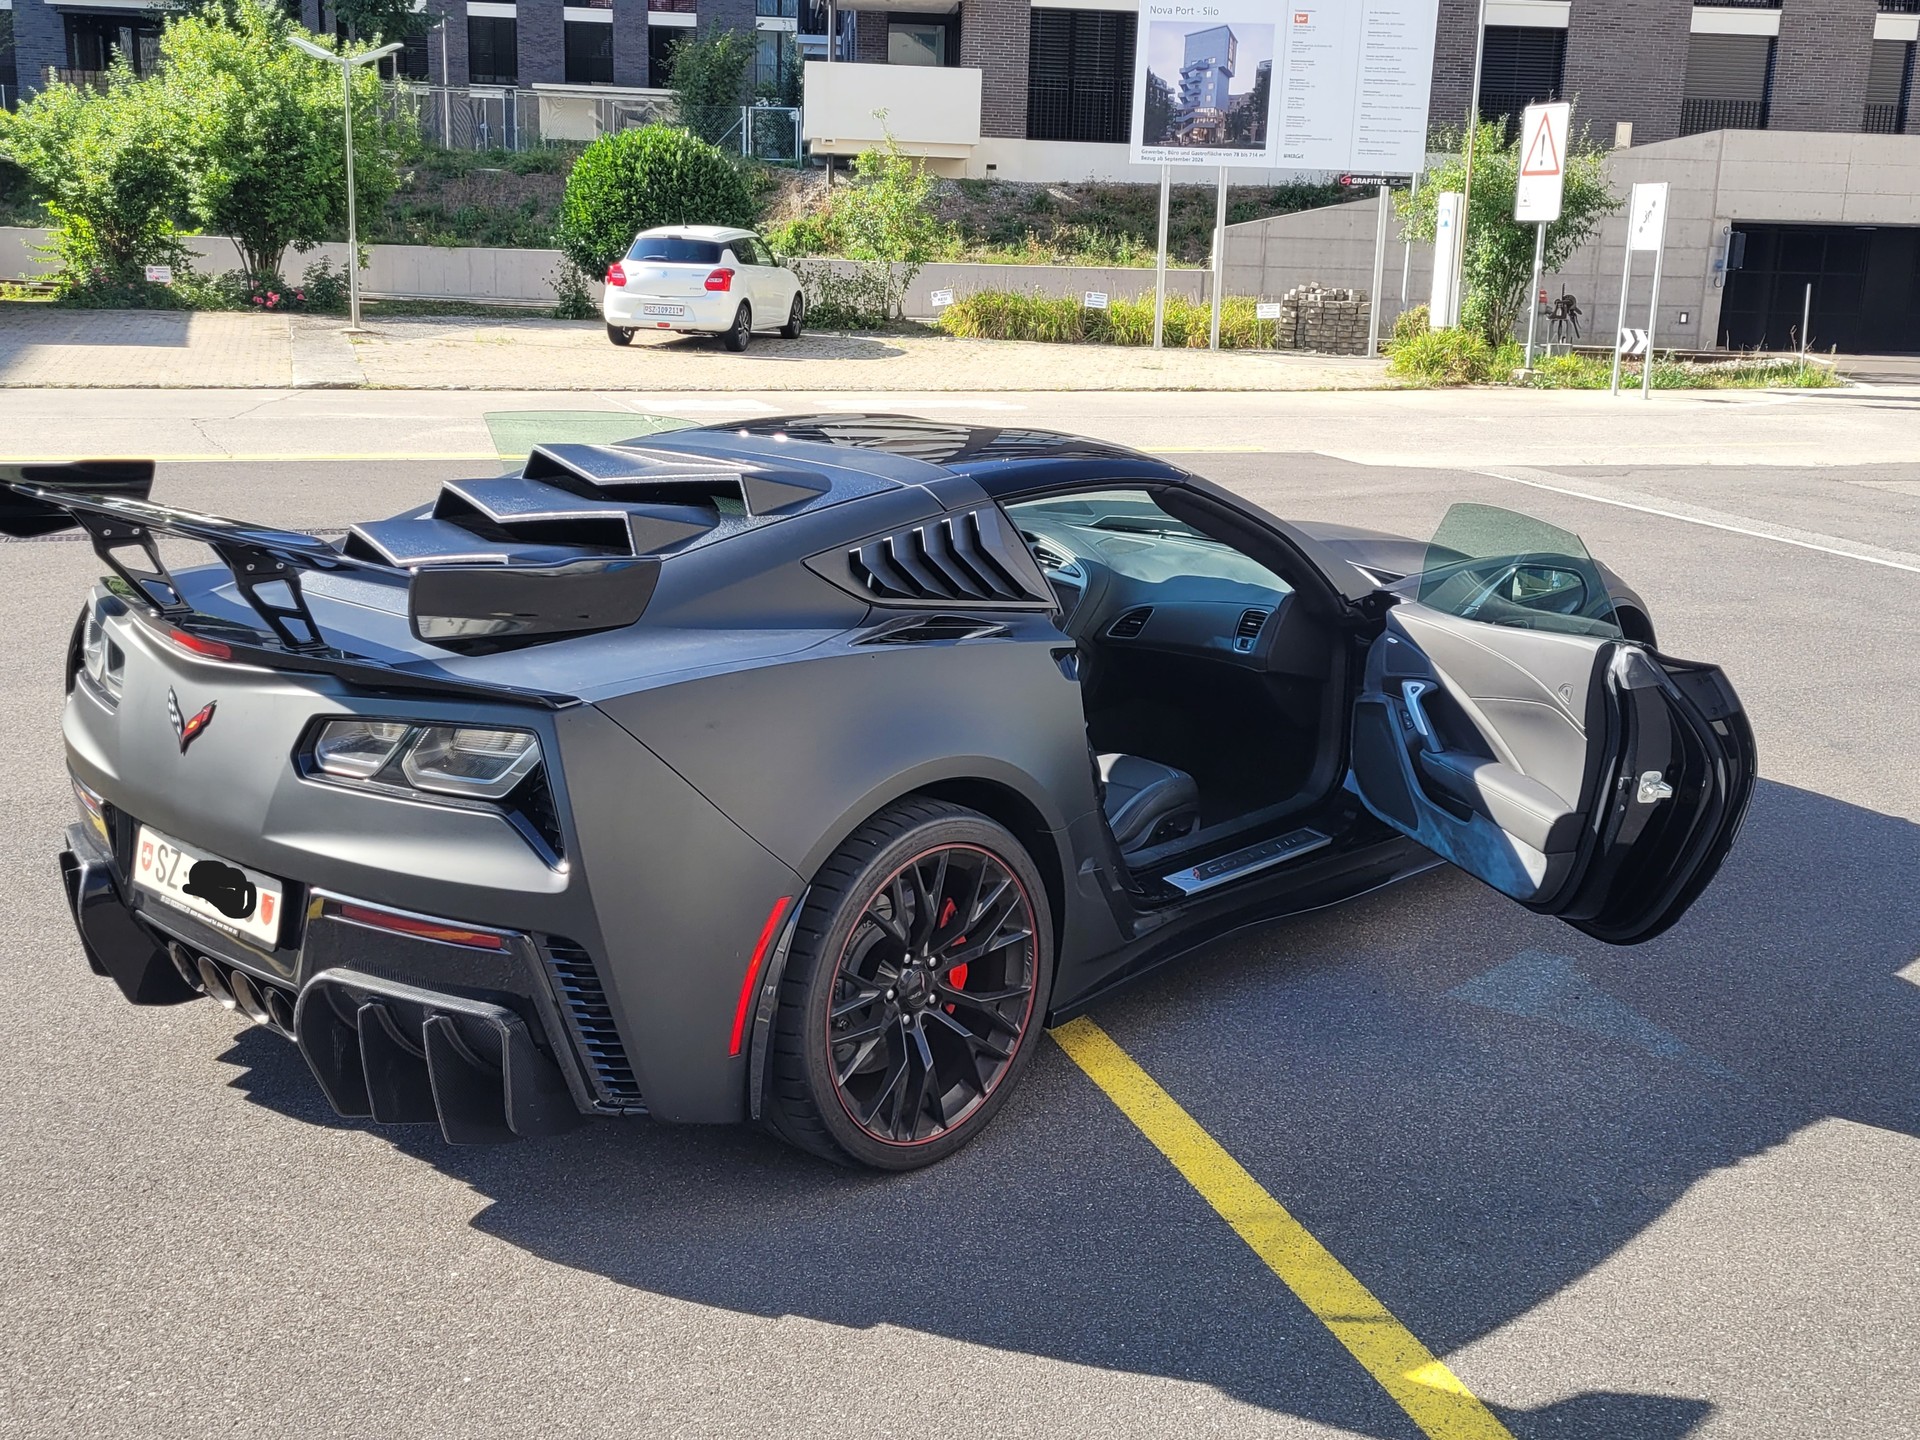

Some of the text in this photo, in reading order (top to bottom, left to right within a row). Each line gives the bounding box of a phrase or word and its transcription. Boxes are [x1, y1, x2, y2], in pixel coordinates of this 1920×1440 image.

[1149, 5, 1173, 14] Nova
[1175, 6, 1194, 15] Port
[1202, 6, 1219, 15] Silo
[1351, 177, 1387, 185] GRAFITEC
